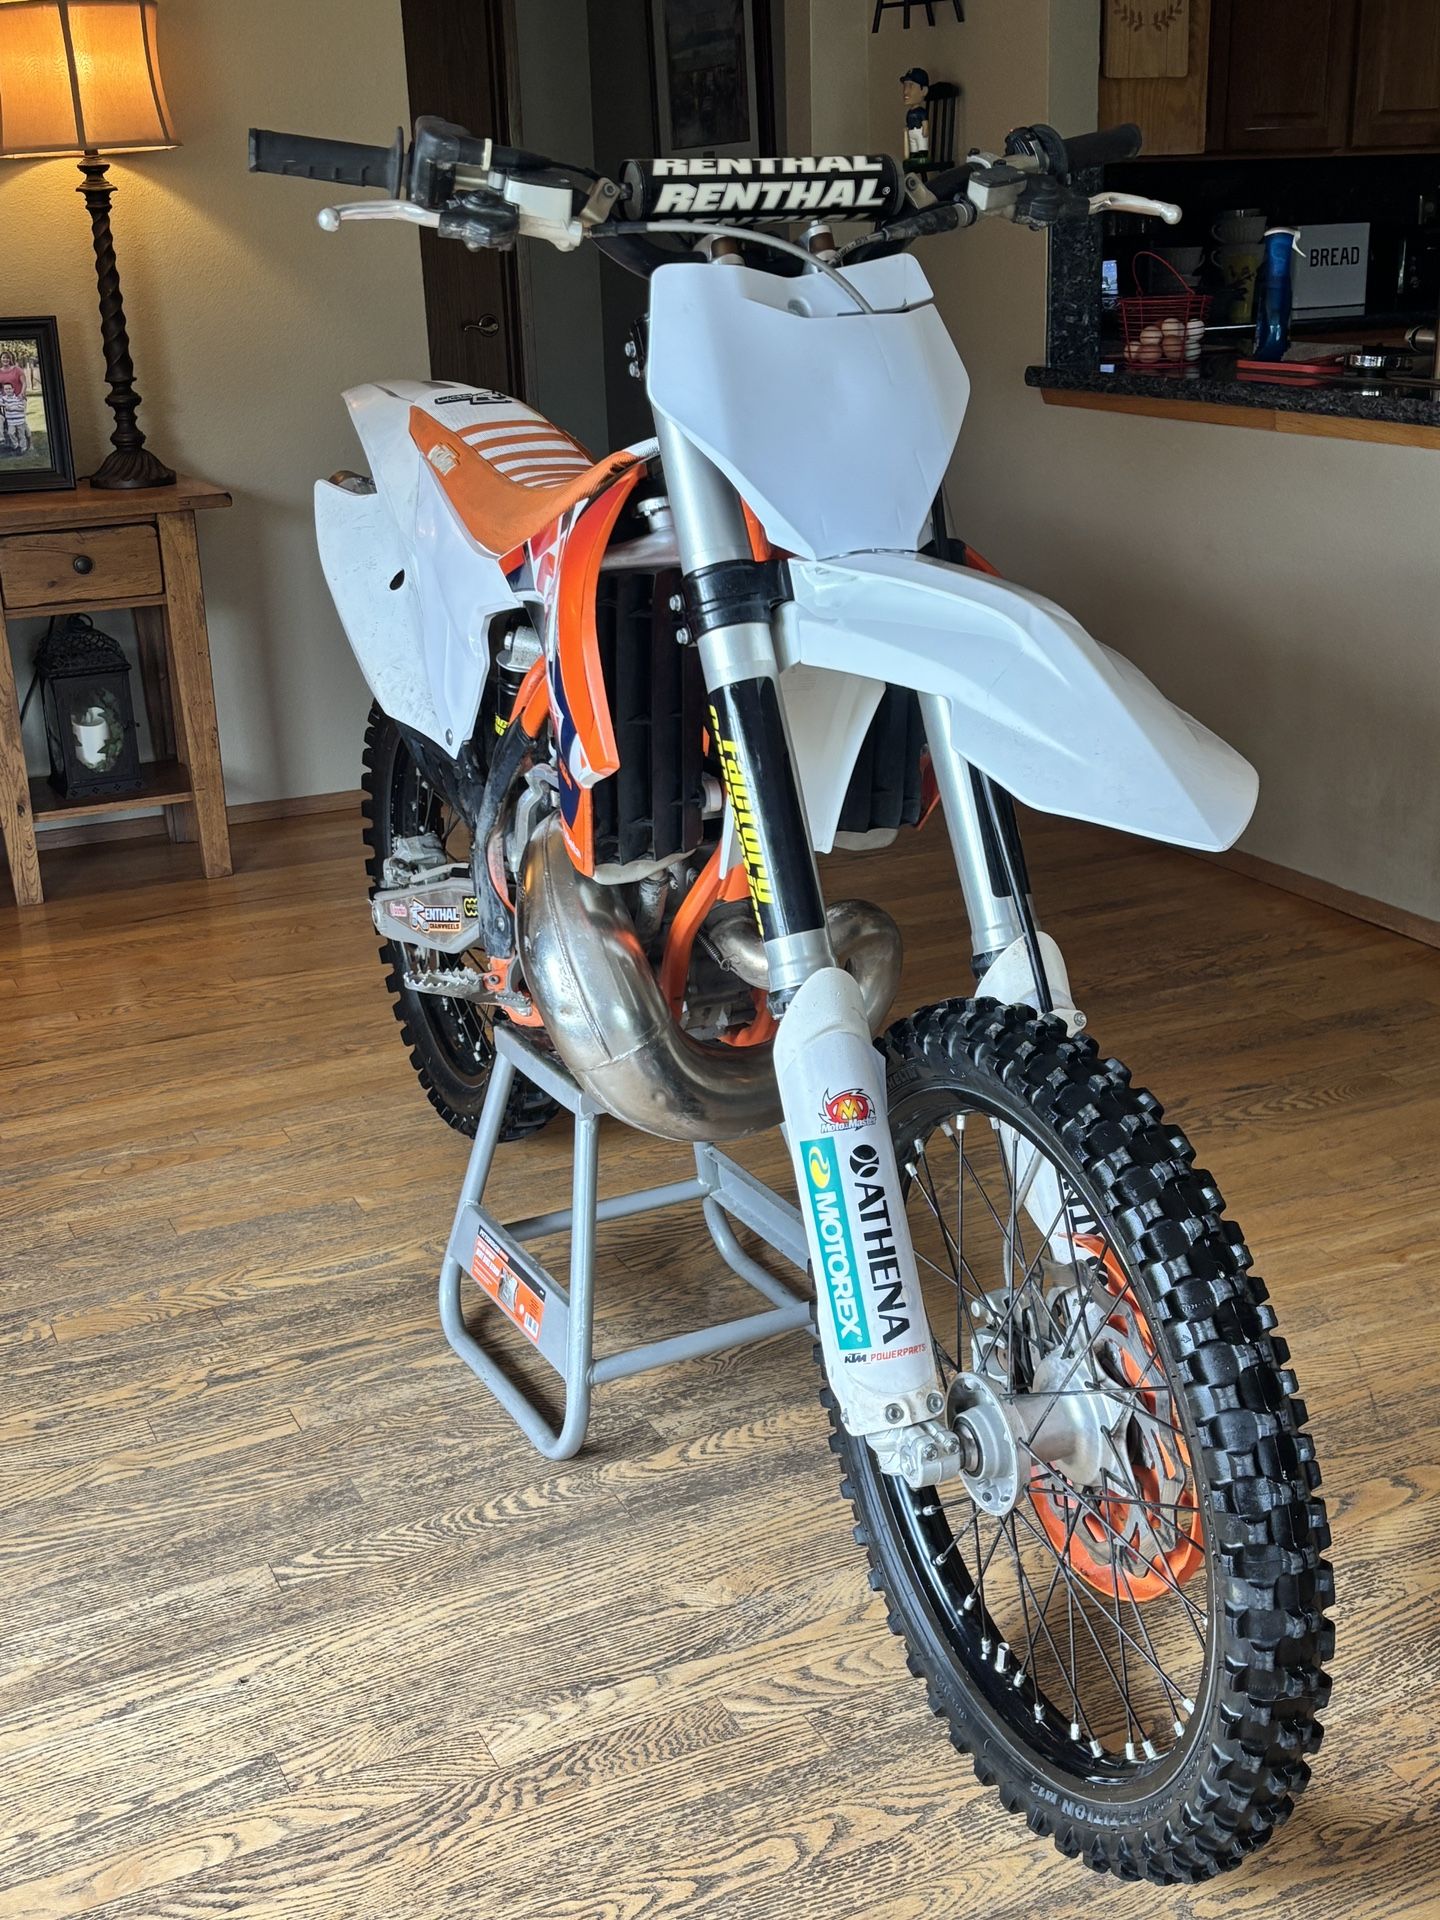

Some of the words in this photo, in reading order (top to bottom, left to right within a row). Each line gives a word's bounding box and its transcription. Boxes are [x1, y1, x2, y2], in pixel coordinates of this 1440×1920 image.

[652, 156, 883, 176] RENTHAL
[653, 178, 887, 214] RENTHAL
[1310, 246, 1360, 267] BREAD
[815, 1191, 863, 1343] MOTOREX
[854, 1181, 911, 1345] ATHENA
[844, 1352, 867, 1364] KTM
[871, 1343, 926, 1362] POWERPARTS
